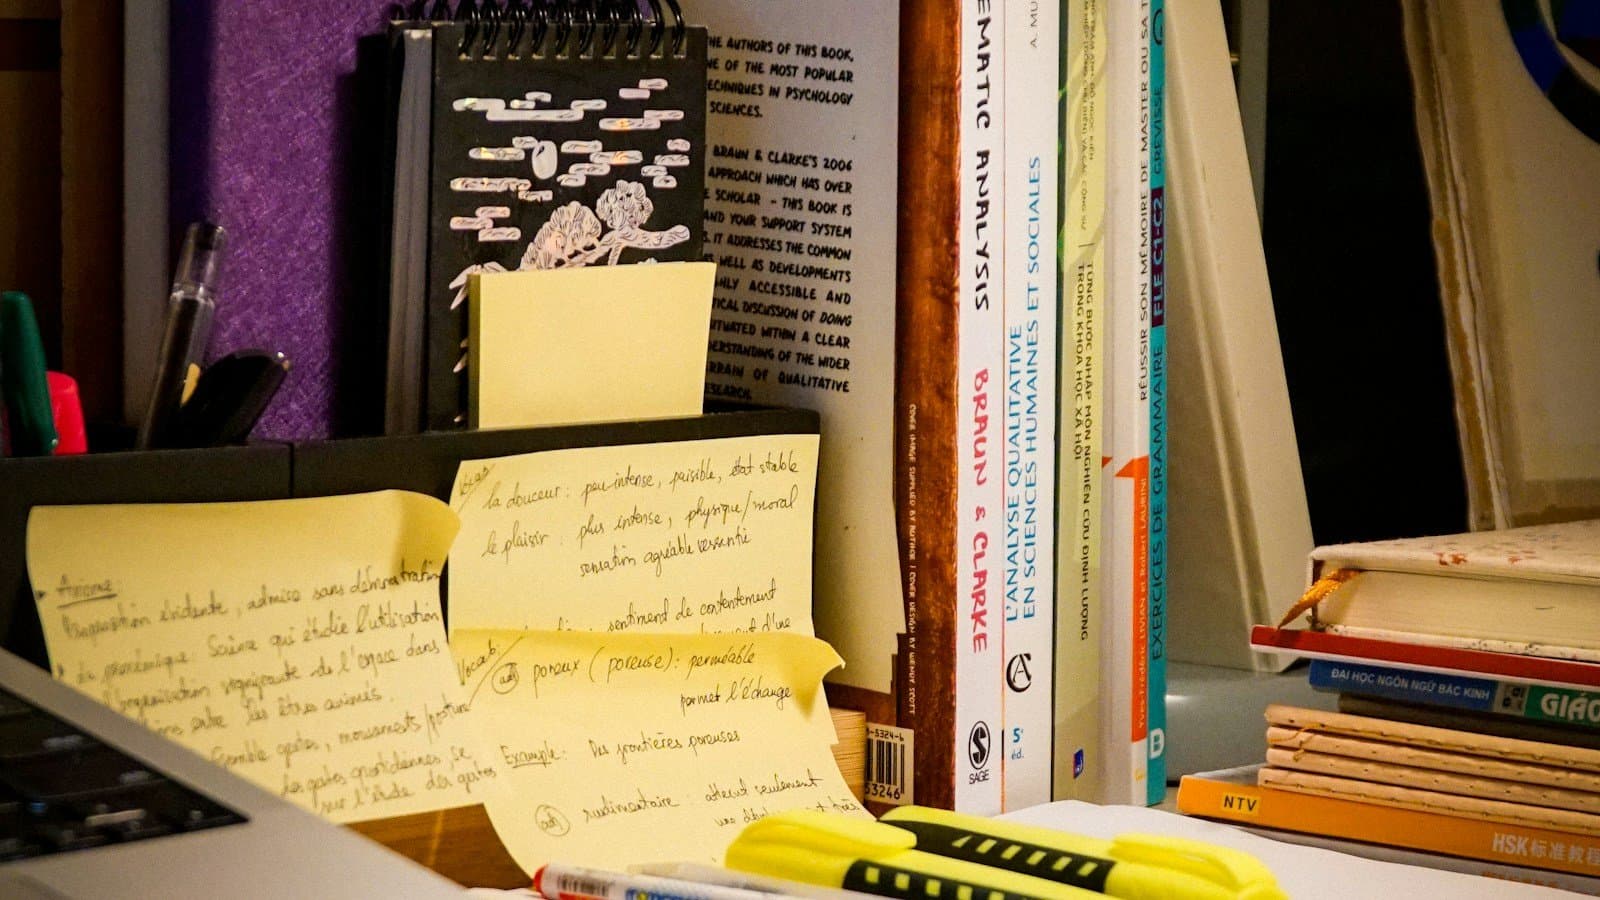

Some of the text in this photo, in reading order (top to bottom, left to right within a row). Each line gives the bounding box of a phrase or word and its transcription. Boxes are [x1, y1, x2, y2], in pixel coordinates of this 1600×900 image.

[727, 38, 853, 62] AUTHORS OF THIS BOOK,
[725, 60, 738, 71] OF
[745, 61, 764, 73] THE
[770, 64, 798, 77] MOST
[804, 67, 853, 82] POPULAR
[710, 101, 763, 117] SCIENCES.
[769, 86, 780, 97] IN
[786, 86, 853, 105] PSYCHOLOGY
[1154, 86, 1163, 175] GREVISSE
[713, 145, 853, 172] BRAUN & CLARKE'S 2006
[708, 167, 852, 194] APPROACH WHICH HAS OVER
[715, 188, 760, 205] SCHOLAR
[782, 197, 803, 210] THIS
[808, 200, 837, 213] BOOK
[842, 203, 852, 216] IS
[1138, 16, 1149, 401] RÉUSSIR SON MÉMOIRE DE MASTER OU SA
[730, 213, 756, 227] YOUR
[762, 216, 805, 232] SUPPORT
[811, 223, 852, 237] SYSTEM
[975, 149, 991, 311] ANALYSIS
[713, 232, 723, 244] IT
[727, 234, 782, 252] ADDRESSES
[786, 241, 804, 254] THE
[808, 243, 852, 261] COMMON
[1153, 198, 1164, 317] FLE C1-C2
[720, 255, 746, 269] WELL
[752, 258, 764, 271] AS
[770, 261, 851, 282] DEVELOPMENTS
[749, 280, 817, 300] ACCESSIBLE
[826, 290, 851, 305] AND
[1076, 263, 1085, 317] TRONG
[742, 301, 798, 320] DISCUSSION
[802, 310, 815, 321] OF
[820, 311, 852, 327] DOING
[761, 325, 850, 349] WITHIN A CLEAR
[1075, 320, 1084, 367] KHOA
[778, 351, 850, 370] OF THE WIDER
[753, 367, 850, 392] OF QUALITATIVE
[1023, 156, 1041, 619] EN SCIENCES HUMAINES ET SOCIALES
[909, 403, 917, 431] COVER
[760, 450, 799, 473] stable
[1006, 325, 1023, 622] L'ANALYSE QUALITATIVE
[970, 368, 990, 654] BRAUN & CLARKE
[1152, 346, 1164, 660] EXERCICES DE GRAMMAIRE
[675, 596, 693, 622] de
[1463, 688, 1490, 700] KINH
[968, 769, 990, 785] SAGE
[1224, 795, 1257, 812] NTV
